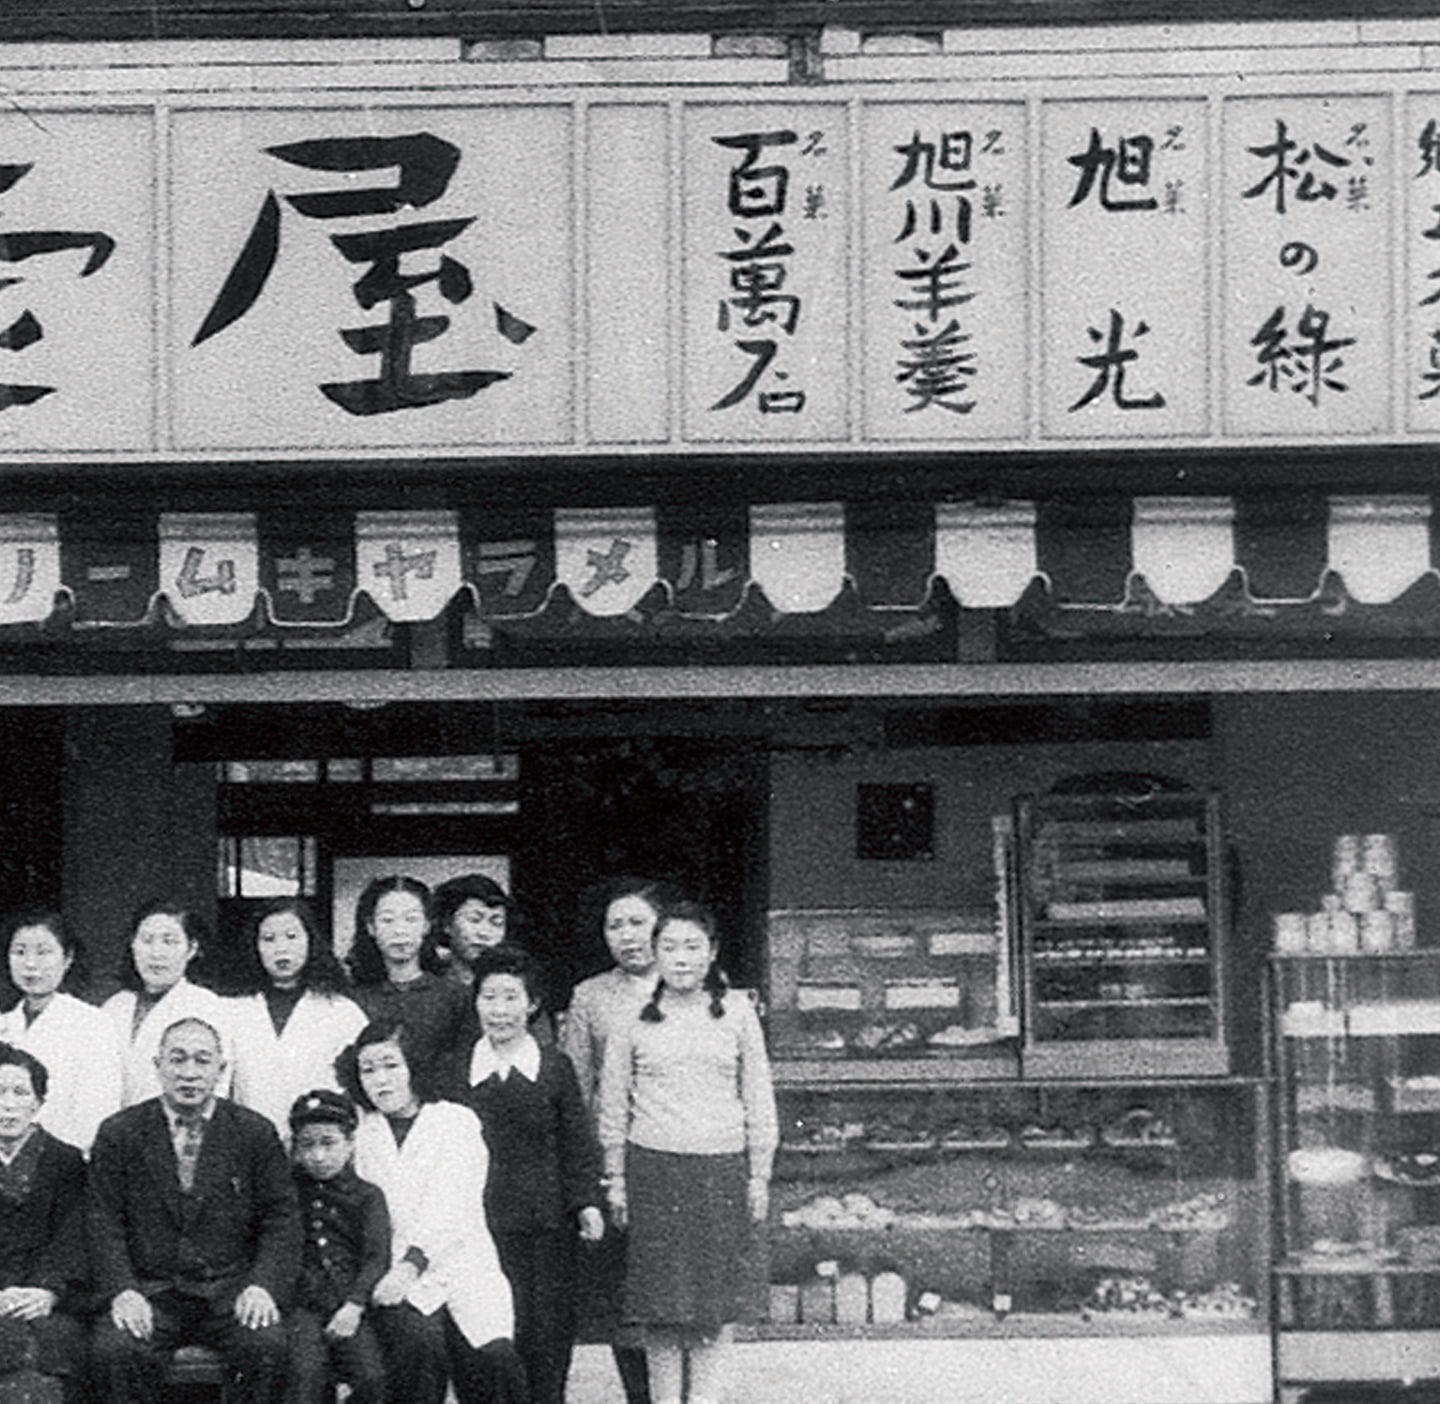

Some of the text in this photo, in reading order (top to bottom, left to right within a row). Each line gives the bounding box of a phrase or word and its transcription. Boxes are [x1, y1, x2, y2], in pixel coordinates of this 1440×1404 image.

[710, 129, 806, 414] 百萬石
[1066, 126, 1167, 413] 旭光
